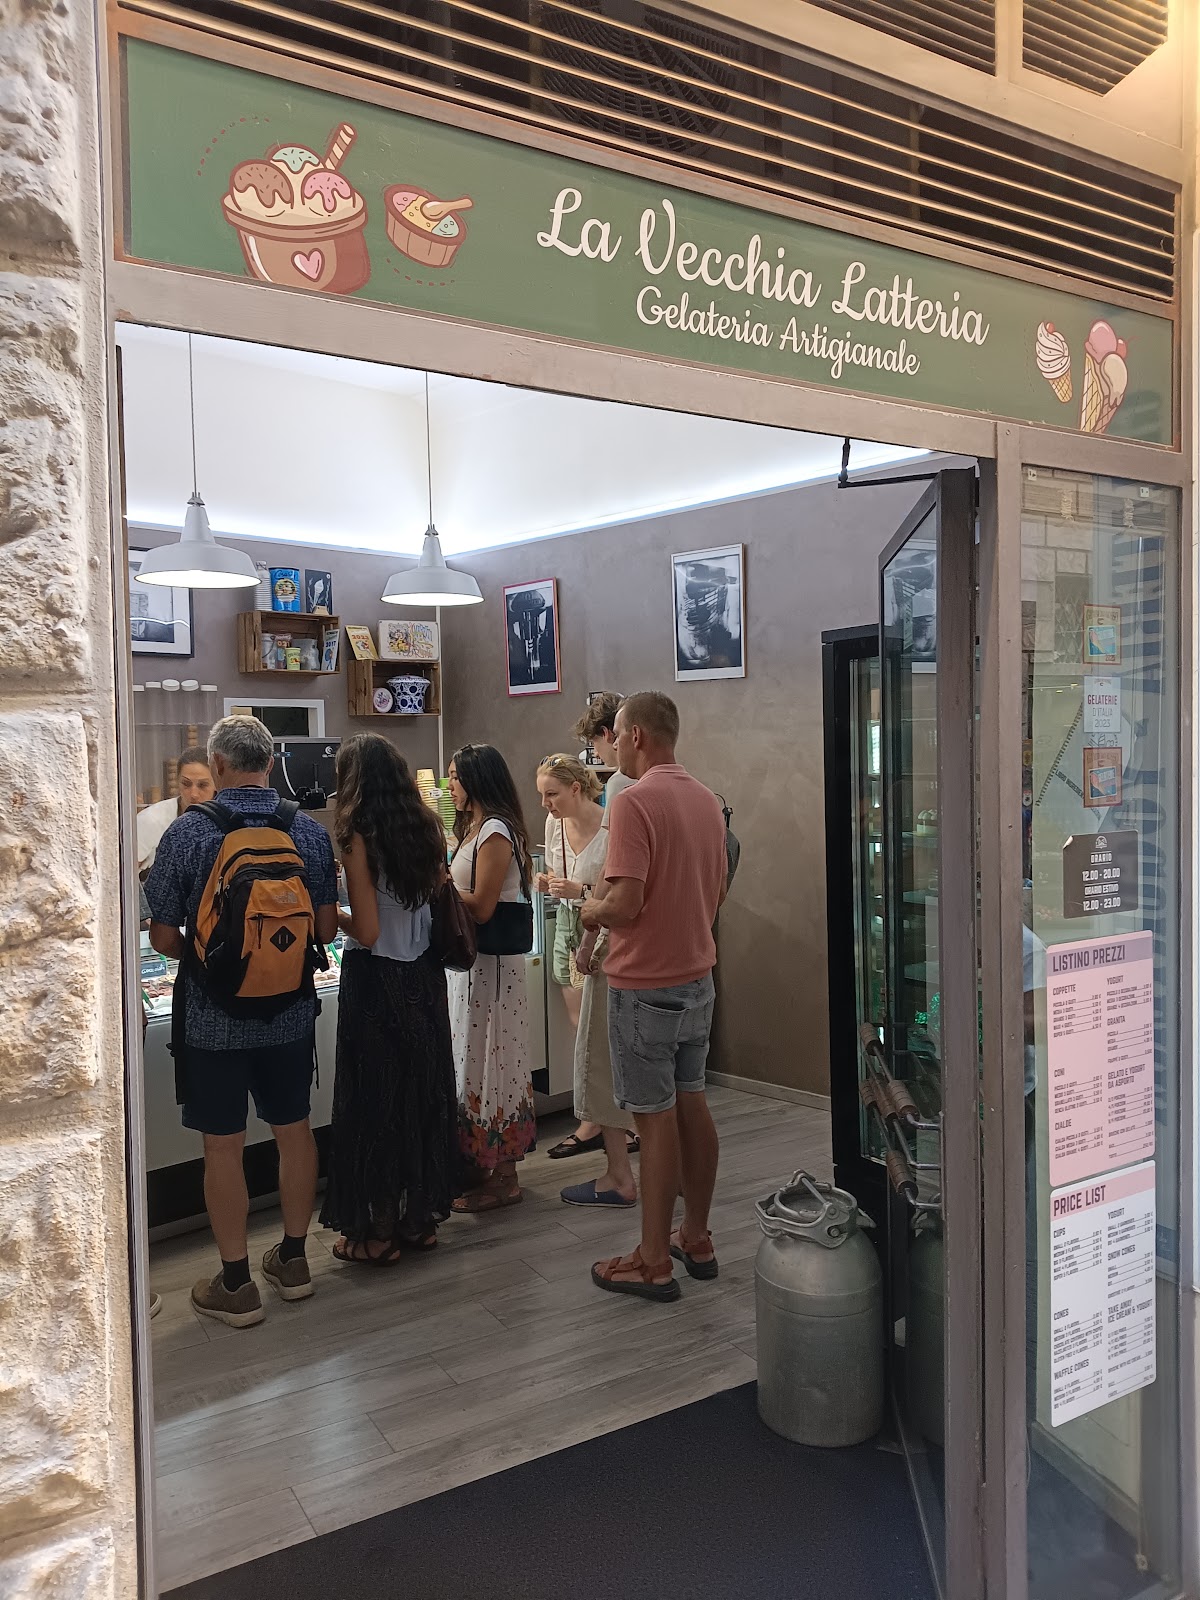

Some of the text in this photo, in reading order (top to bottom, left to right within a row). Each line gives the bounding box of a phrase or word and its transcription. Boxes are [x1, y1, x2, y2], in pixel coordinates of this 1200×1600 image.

[536, 187, 991, 347] La Vecchia Latteria
[635, 285, 921, 379] Gelateria Artigianale
[1088, 694, 1118, 705] GELATERIE
[1094, 719, 1110, 727] 2023
[1090, 853, 1112, 863] ORARIO
[1082, 870, 1098, 881] 12.00
[1103, 868, 1120, 879] 20.00
[1085, 883, 1119, 895] ORARIO ESTIVO
[1083, 900, 1099, 911] 12.00
[1104, 897, 1121, 908] 23.00
[1052, 944, 1125, 972] LISTINO PREZZI
[1053, 984, 1076, 996] COPPETTE
[1107, 1016, 1125, 1026] GRANITA
[1054, 1068, 1065, 1078] CONI
[1108, 1068, 1124, 1080] GELATO
[1125, 1067, 1128, 1075] E
[1108, 1075, 1134, 1089] DA ASPORTO
[1055, 1119, 1072, 1130] CIALDE
[1054, 1185, 1106, 1216] PRICE LIST
[1054, 1228, 1065, 1238] CUPS
[1108, 1244, 1135, 1261] SNOW CONES
[1108, 1299, 1132, 1315] TAKE AWAY
[1054, 1308, 1069, 1321] CONES
[1116, 1309, 1131, 1321] CREAM
[1054, 1359, 1089, 1380] WAFFLE CONES
